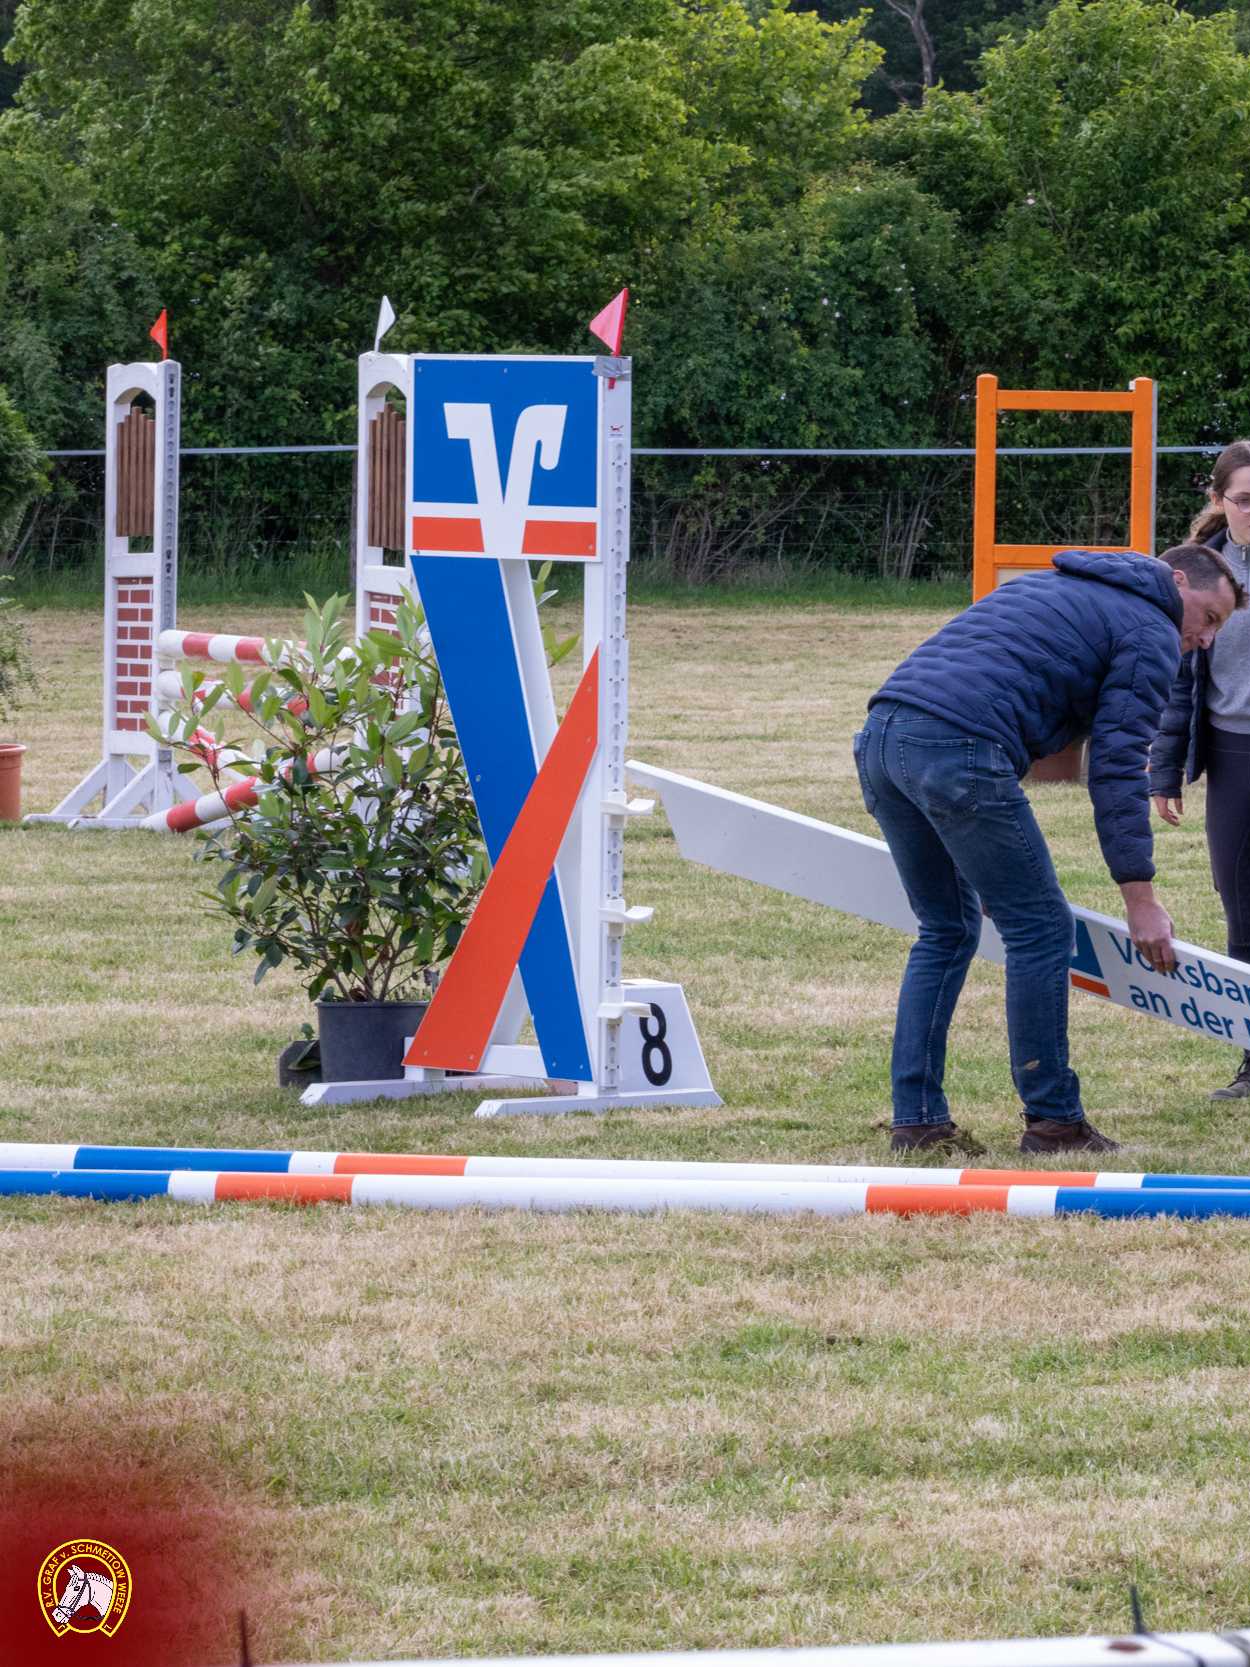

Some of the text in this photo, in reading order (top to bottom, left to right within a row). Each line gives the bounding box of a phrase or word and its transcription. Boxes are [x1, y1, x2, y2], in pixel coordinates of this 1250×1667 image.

[639, 1002, 672, 1087] 8
[1129, 984, 1172, 1018] an
[1181, 997, 1235, 1039] der
